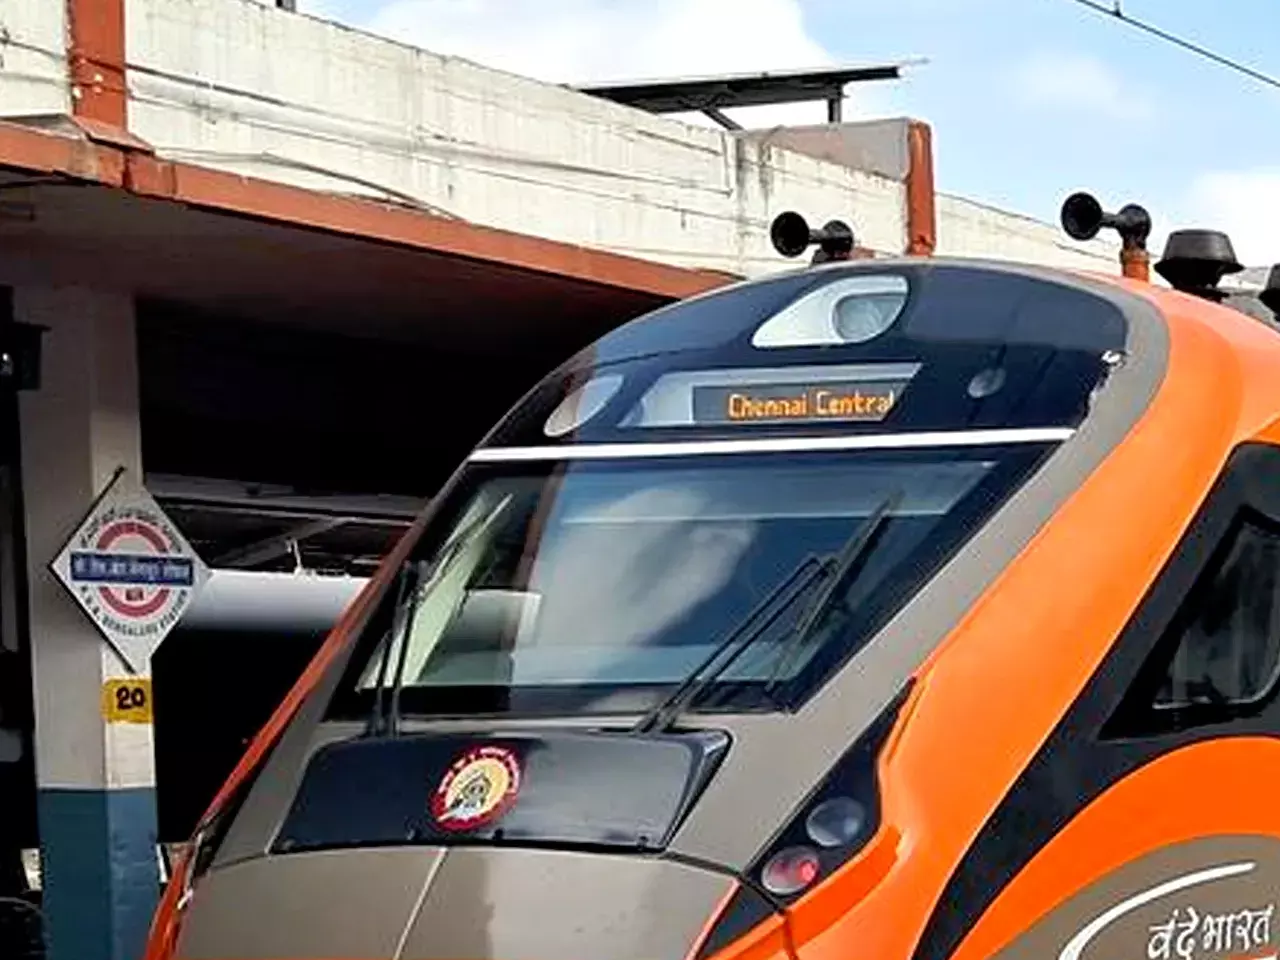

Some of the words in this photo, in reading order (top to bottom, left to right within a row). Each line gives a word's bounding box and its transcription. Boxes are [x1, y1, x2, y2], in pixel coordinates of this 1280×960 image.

[728, 393, 807, 419] Chennai
[816, 390, 895, 416] Central
[116, 686, 146, 710] 20
